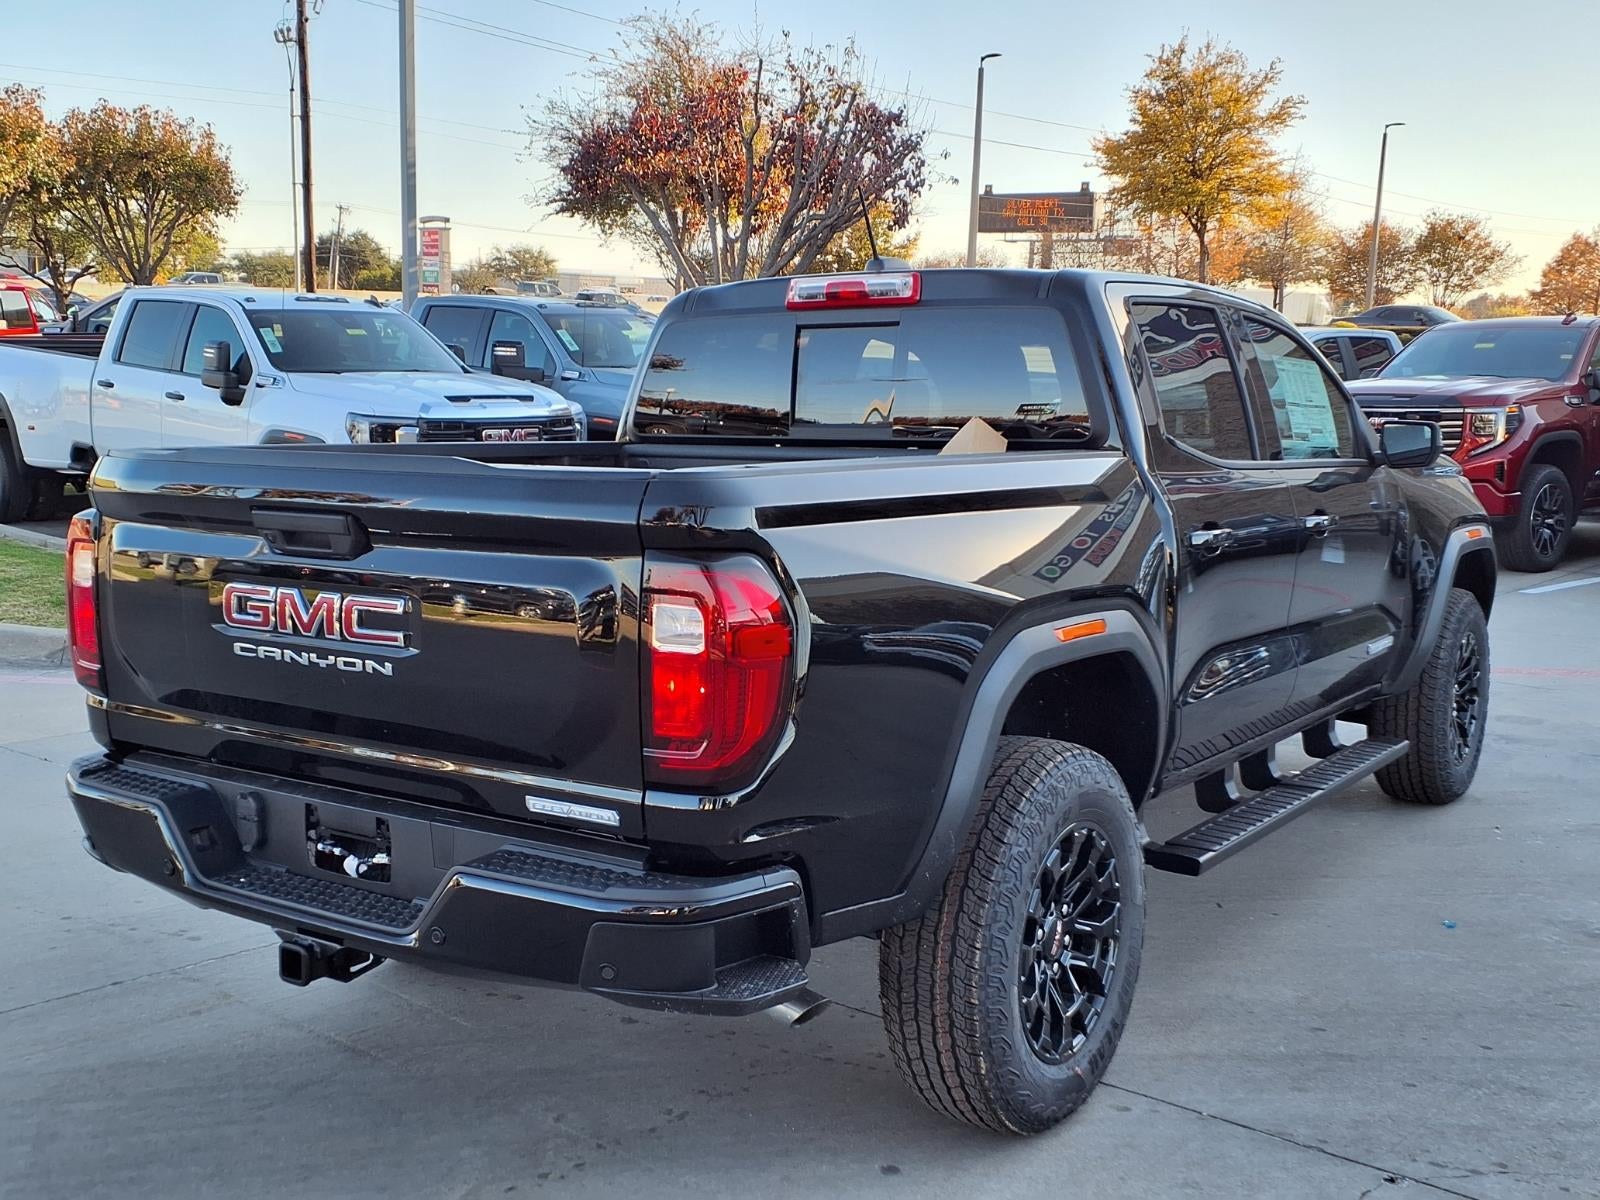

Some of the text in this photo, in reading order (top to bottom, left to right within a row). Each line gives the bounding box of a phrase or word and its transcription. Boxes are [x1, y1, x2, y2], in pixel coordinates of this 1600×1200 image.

[1035, 198, 1058, 208] ALERT
[1054, 207, 1065, 217] TX
[1017, 217, 1035, 226] CALL
[482, 428, 539, 442] GMC
[223, 582, 408, 648] GMC
[233, 642, 394, 677] CANYON
